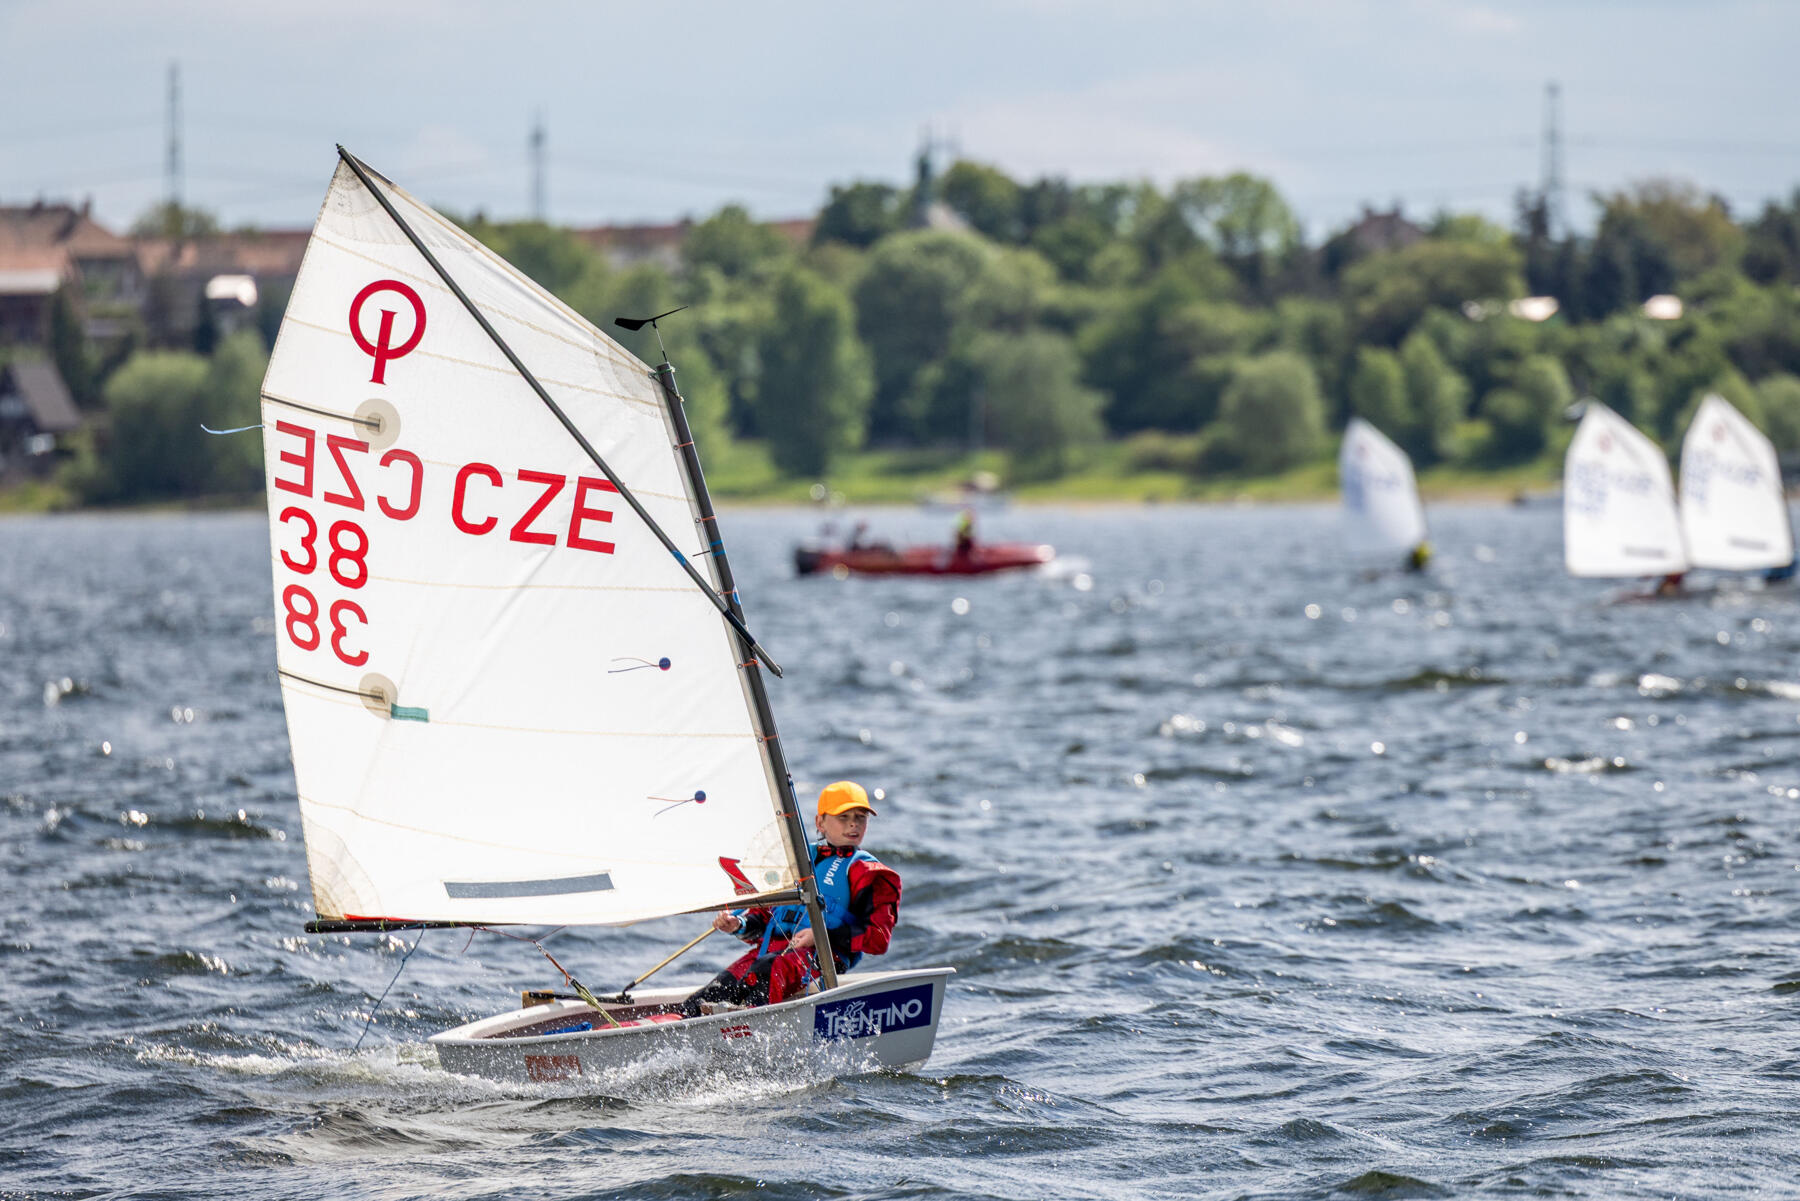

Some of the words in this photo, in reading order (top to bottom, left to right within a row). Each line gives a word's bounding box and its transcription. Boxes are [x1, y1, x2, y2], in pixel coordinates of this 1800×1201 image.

[280, 507, 368, 589] 38
[452, 463, 622, 554] CZE
[824, 998, 923, 1037] TRENTINO
